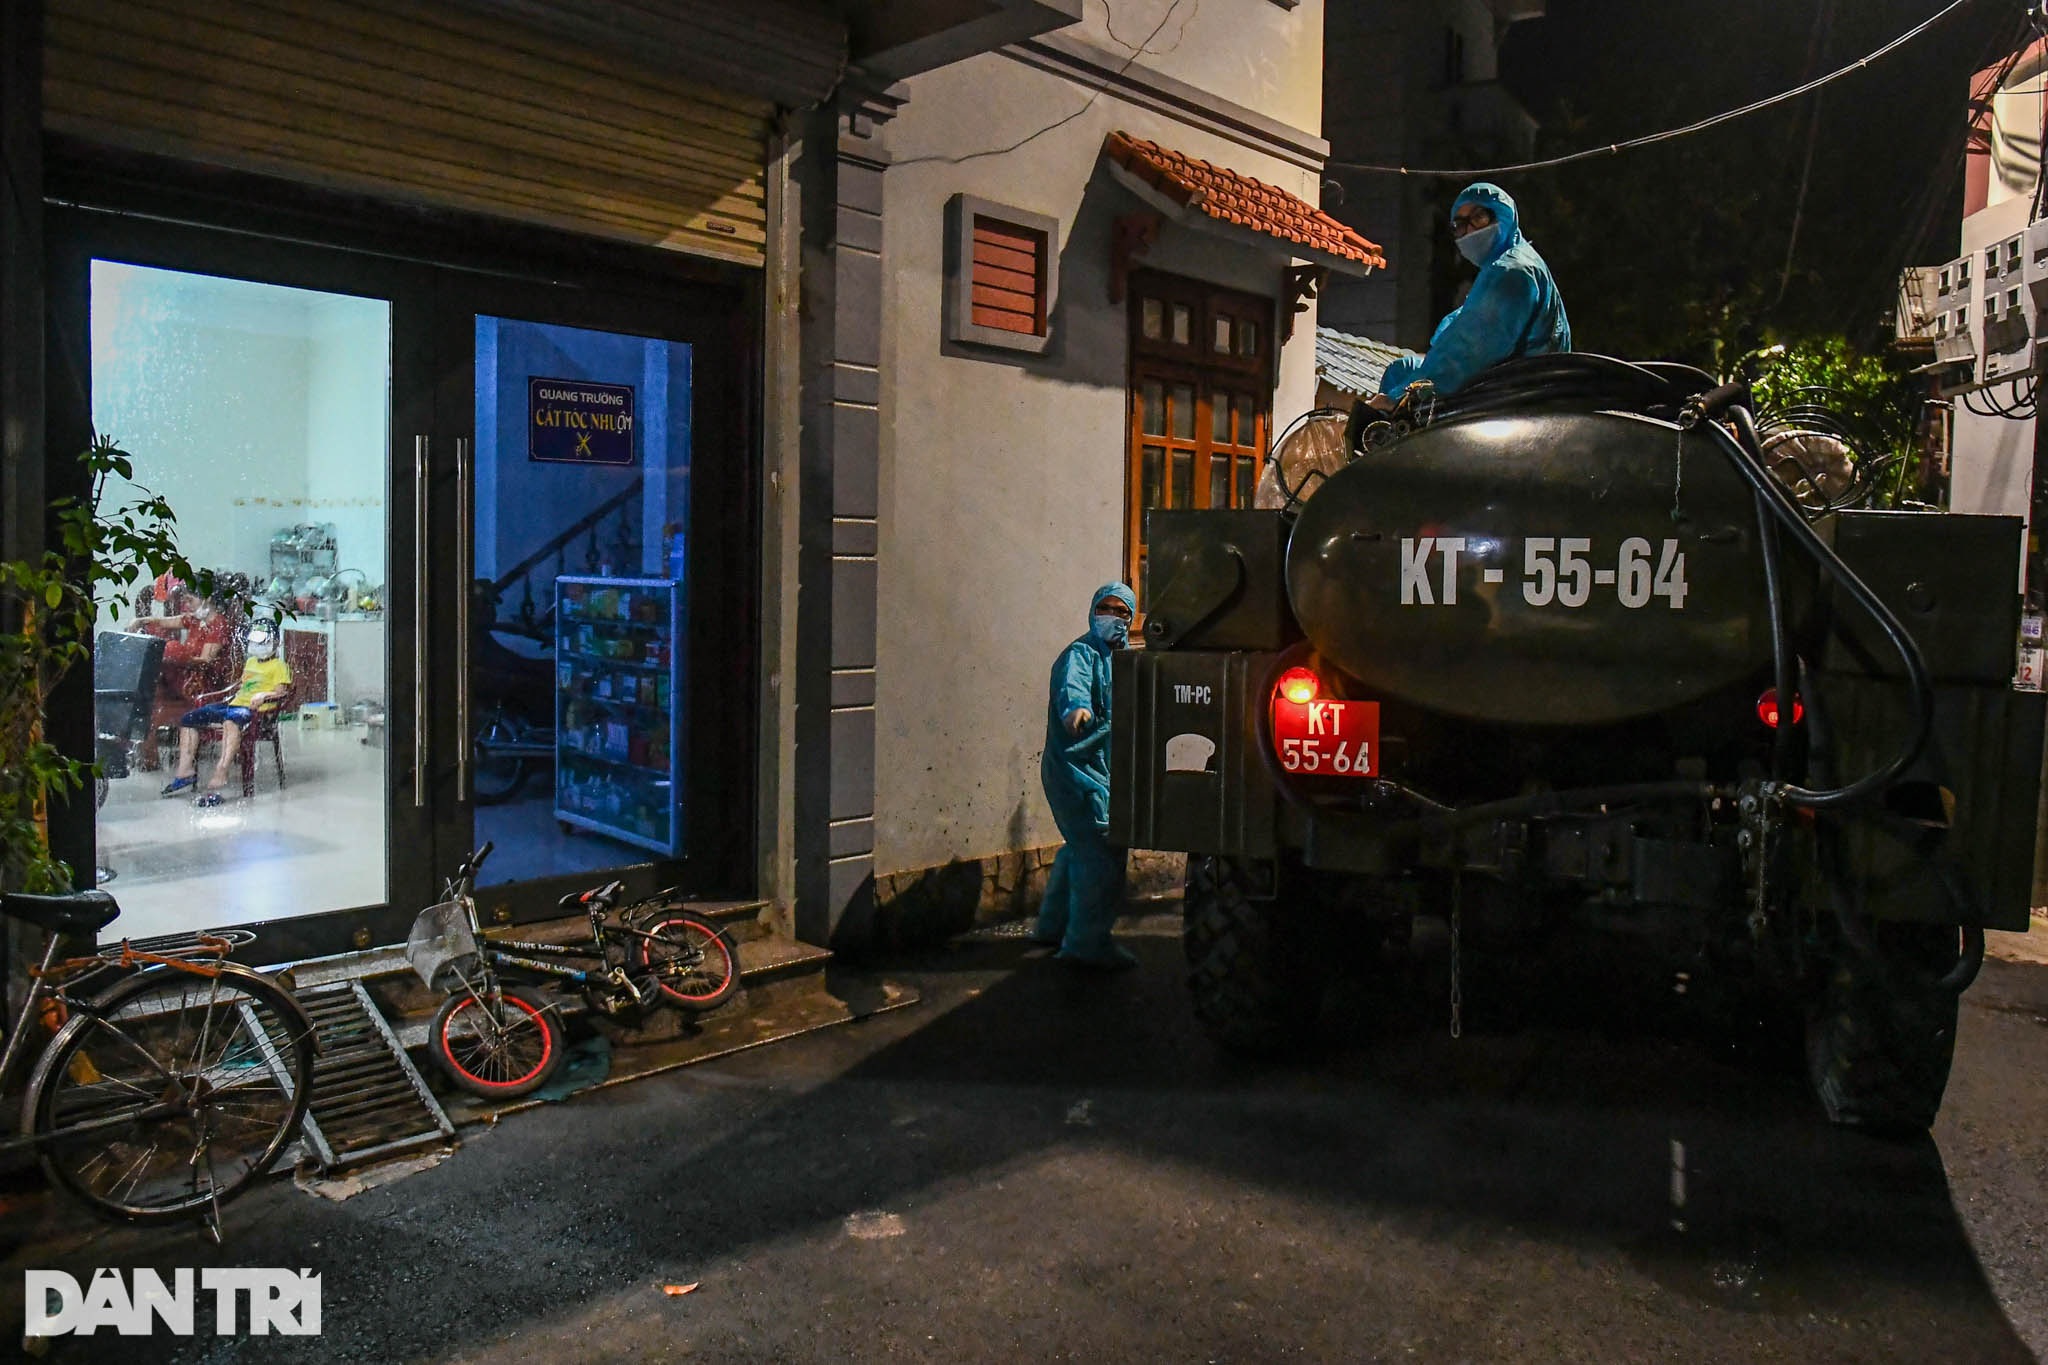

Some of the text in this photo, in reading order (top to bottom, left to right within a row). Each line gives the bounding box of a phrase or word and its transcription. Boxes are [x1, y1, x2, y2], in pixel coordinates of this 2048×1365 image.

[540, 388, 624, 405] QUANG TRƯỜNG
[564, 408, 588, 429] TÓC
[1400, 537, 1466, 605] KT
[1522, 536, 1688, 609] 55-64
[1173, 684, 1211, 705] TM-PC
[1308, 702, 1346, 736] KT
[1283, 738, 1370, 774] 55-64
